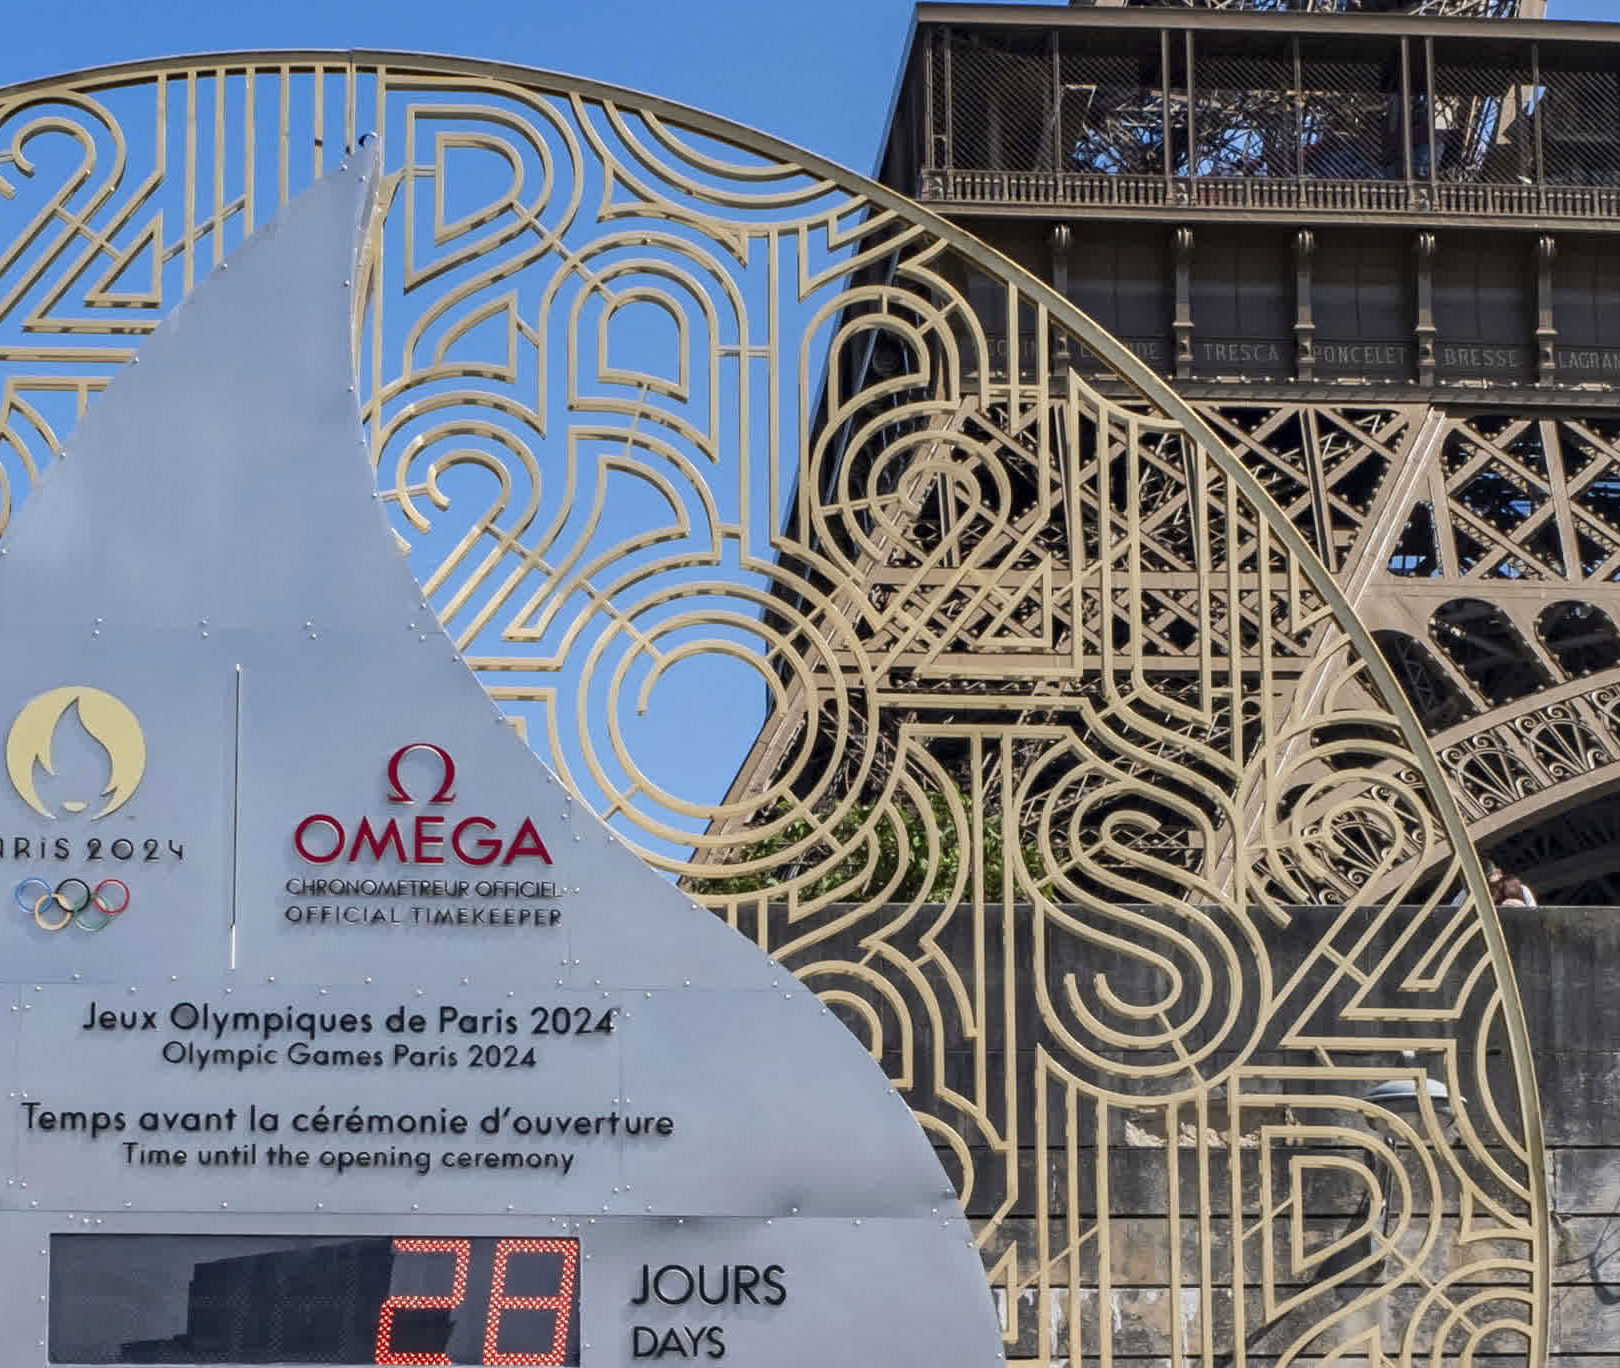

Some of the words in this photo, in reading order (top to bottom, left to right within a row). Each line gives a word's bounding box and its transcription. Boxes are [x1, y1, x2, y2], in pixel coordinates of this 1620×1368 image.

[86, 837, 185, 861] 2024
[293, 814, 555, 867] OMEGA
[475, 879, 564, 900] OFFICIEL
[284, 904, 403, 926] OFFICIAL
[411, 906, 562, 927] TIMEKEEPER
[82, 1002, 157, 1032] Jeux
[170, 1003, 373, 1040] Olympiques
[384, 1005, 427, 1034] de
[439, 1007, 518, 1035] Paris
[530, 1006, 616, 1035] 2024
[162, 1041, 278, 1071] Olympic
[287, 1042, 385, 1067] Games
[394, 1045, 458, 1068] Paris
[467, 1044, 537, 1068] 2024
[24, 1103, 127, 1138] Temps
[138, 1106, 237, 1132] avant
[250, 1105, 279, 1132] la
[291, 1104, 469, 1134] cérémonie
[481, 1106, 675, 1137] d'ouverture
[123, 1142, 187, 1166] Time
[198, 1143, 256, 1167] until
[267, 1144, 309, 1168] the
[319, 1146, 432, 1174] opening
[441, 1147, 575, 1175] ceremony
[631, 1264, 786, 1305] JOURS
[375, 1239, 579, 1367] 28
[632, 1326, 725, 1358] DAYS
